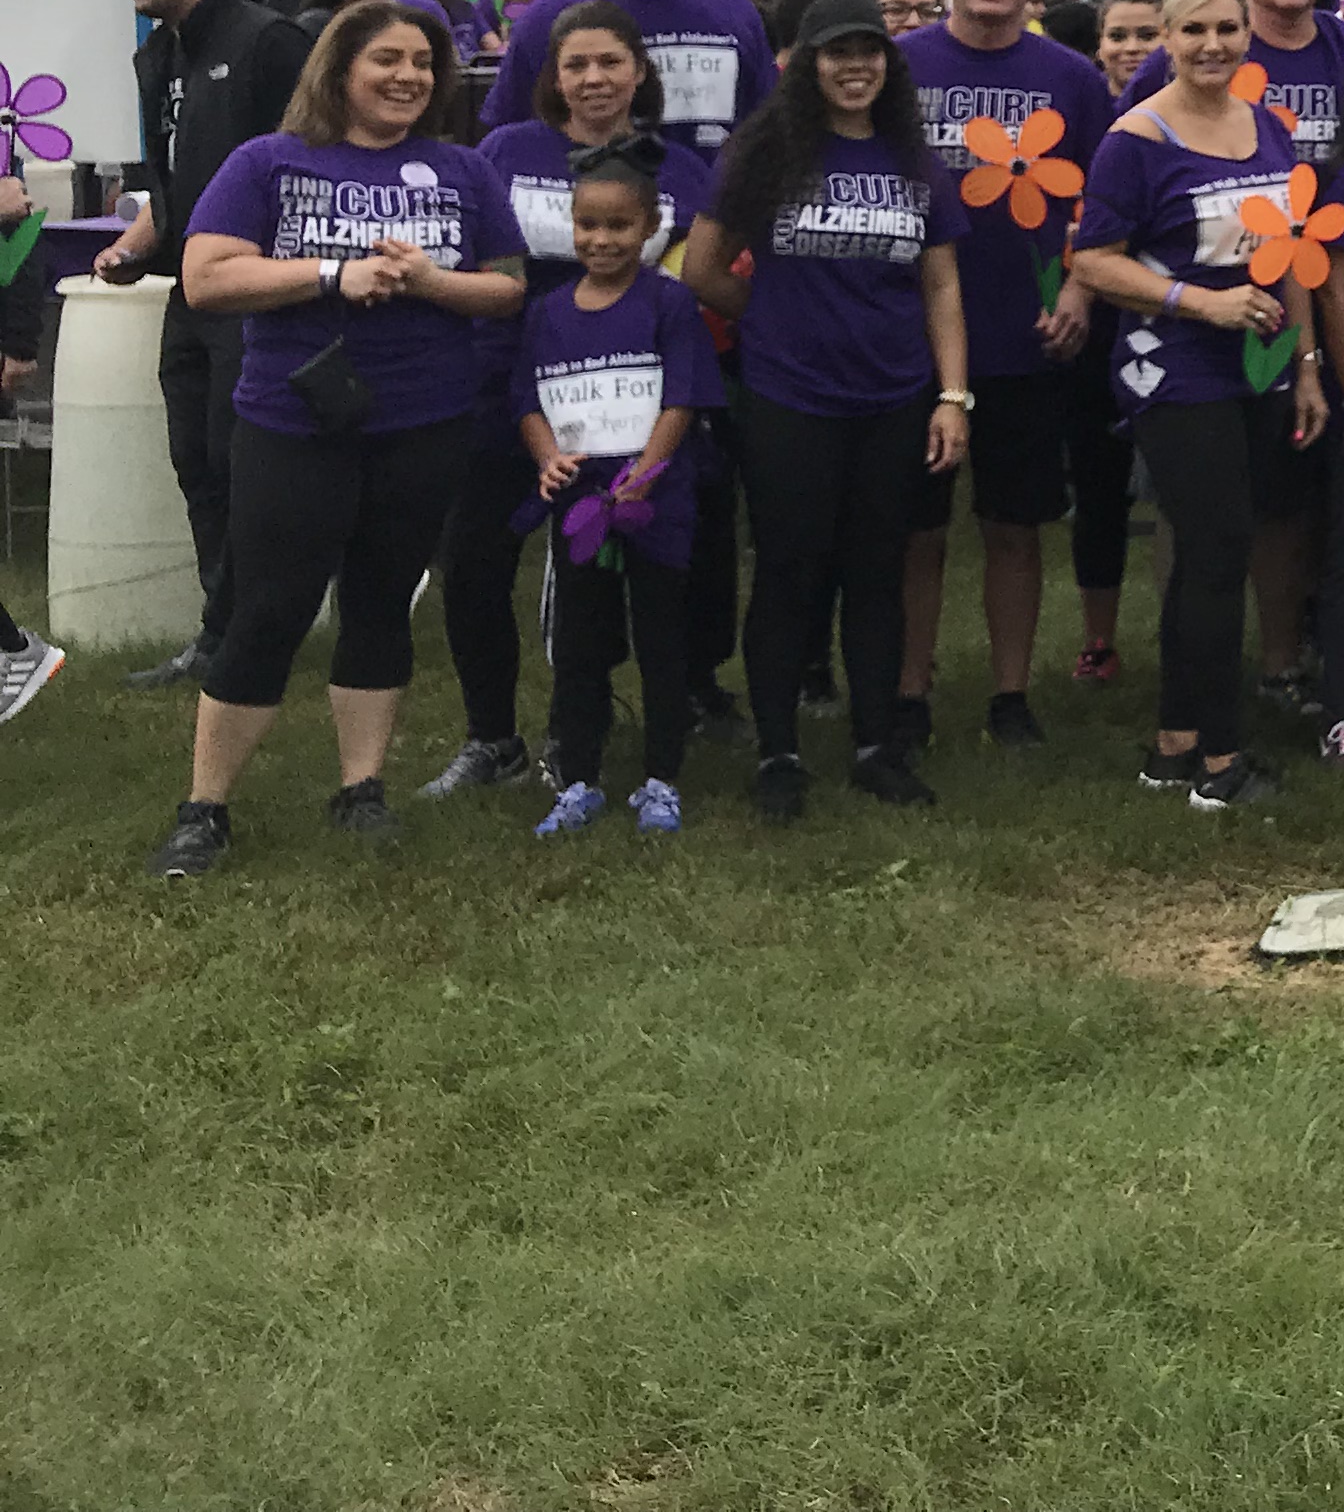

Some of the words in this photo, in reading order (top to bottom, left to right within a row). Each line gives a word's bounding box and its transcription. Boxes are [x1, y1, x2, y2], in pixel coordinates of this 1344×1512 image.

[686, 53, 722, 73] For
[280, 174, 333, 197] FIND
[280, 195, 333, 217] THE
[335, 180, 462, 223] CURE
[548, 377, 604, 407] Walk
[614, 375, 658, 399] For
